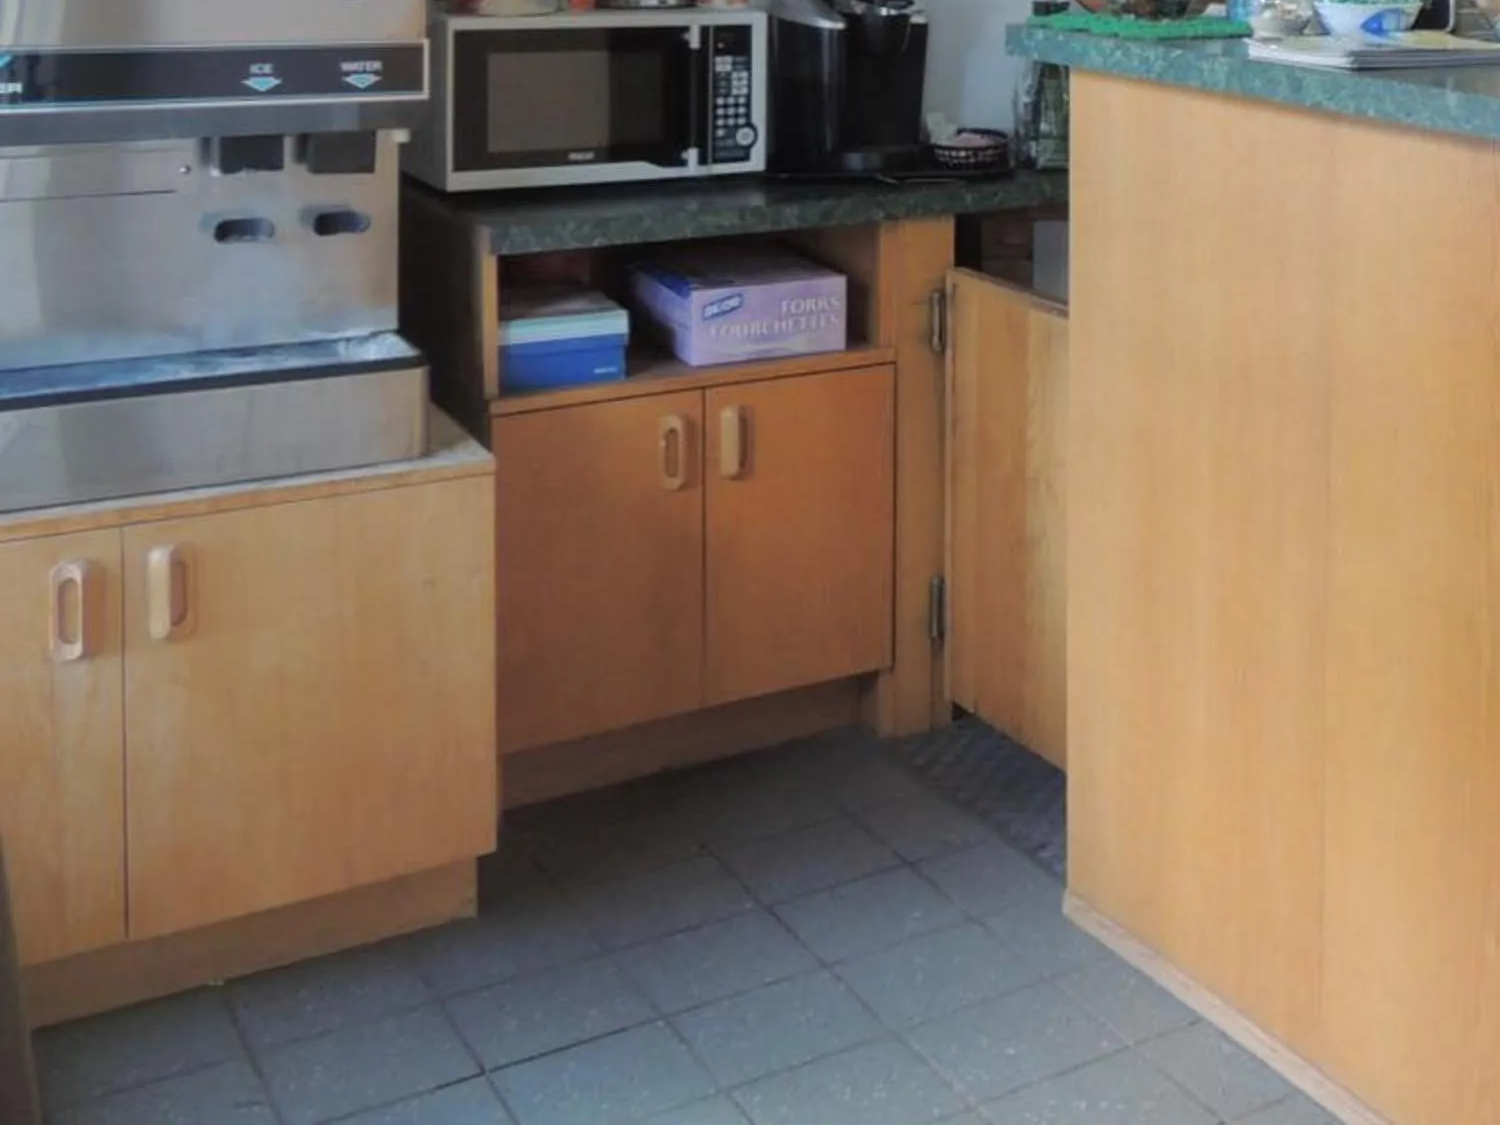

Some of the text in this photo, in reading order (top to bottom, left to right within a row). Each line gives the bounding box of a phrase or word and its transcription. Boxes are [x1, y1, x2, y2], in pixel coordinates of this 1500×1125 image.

[249, 61, 384, 74] ICE WATER
[780, 296, 840, 313] FORKS
